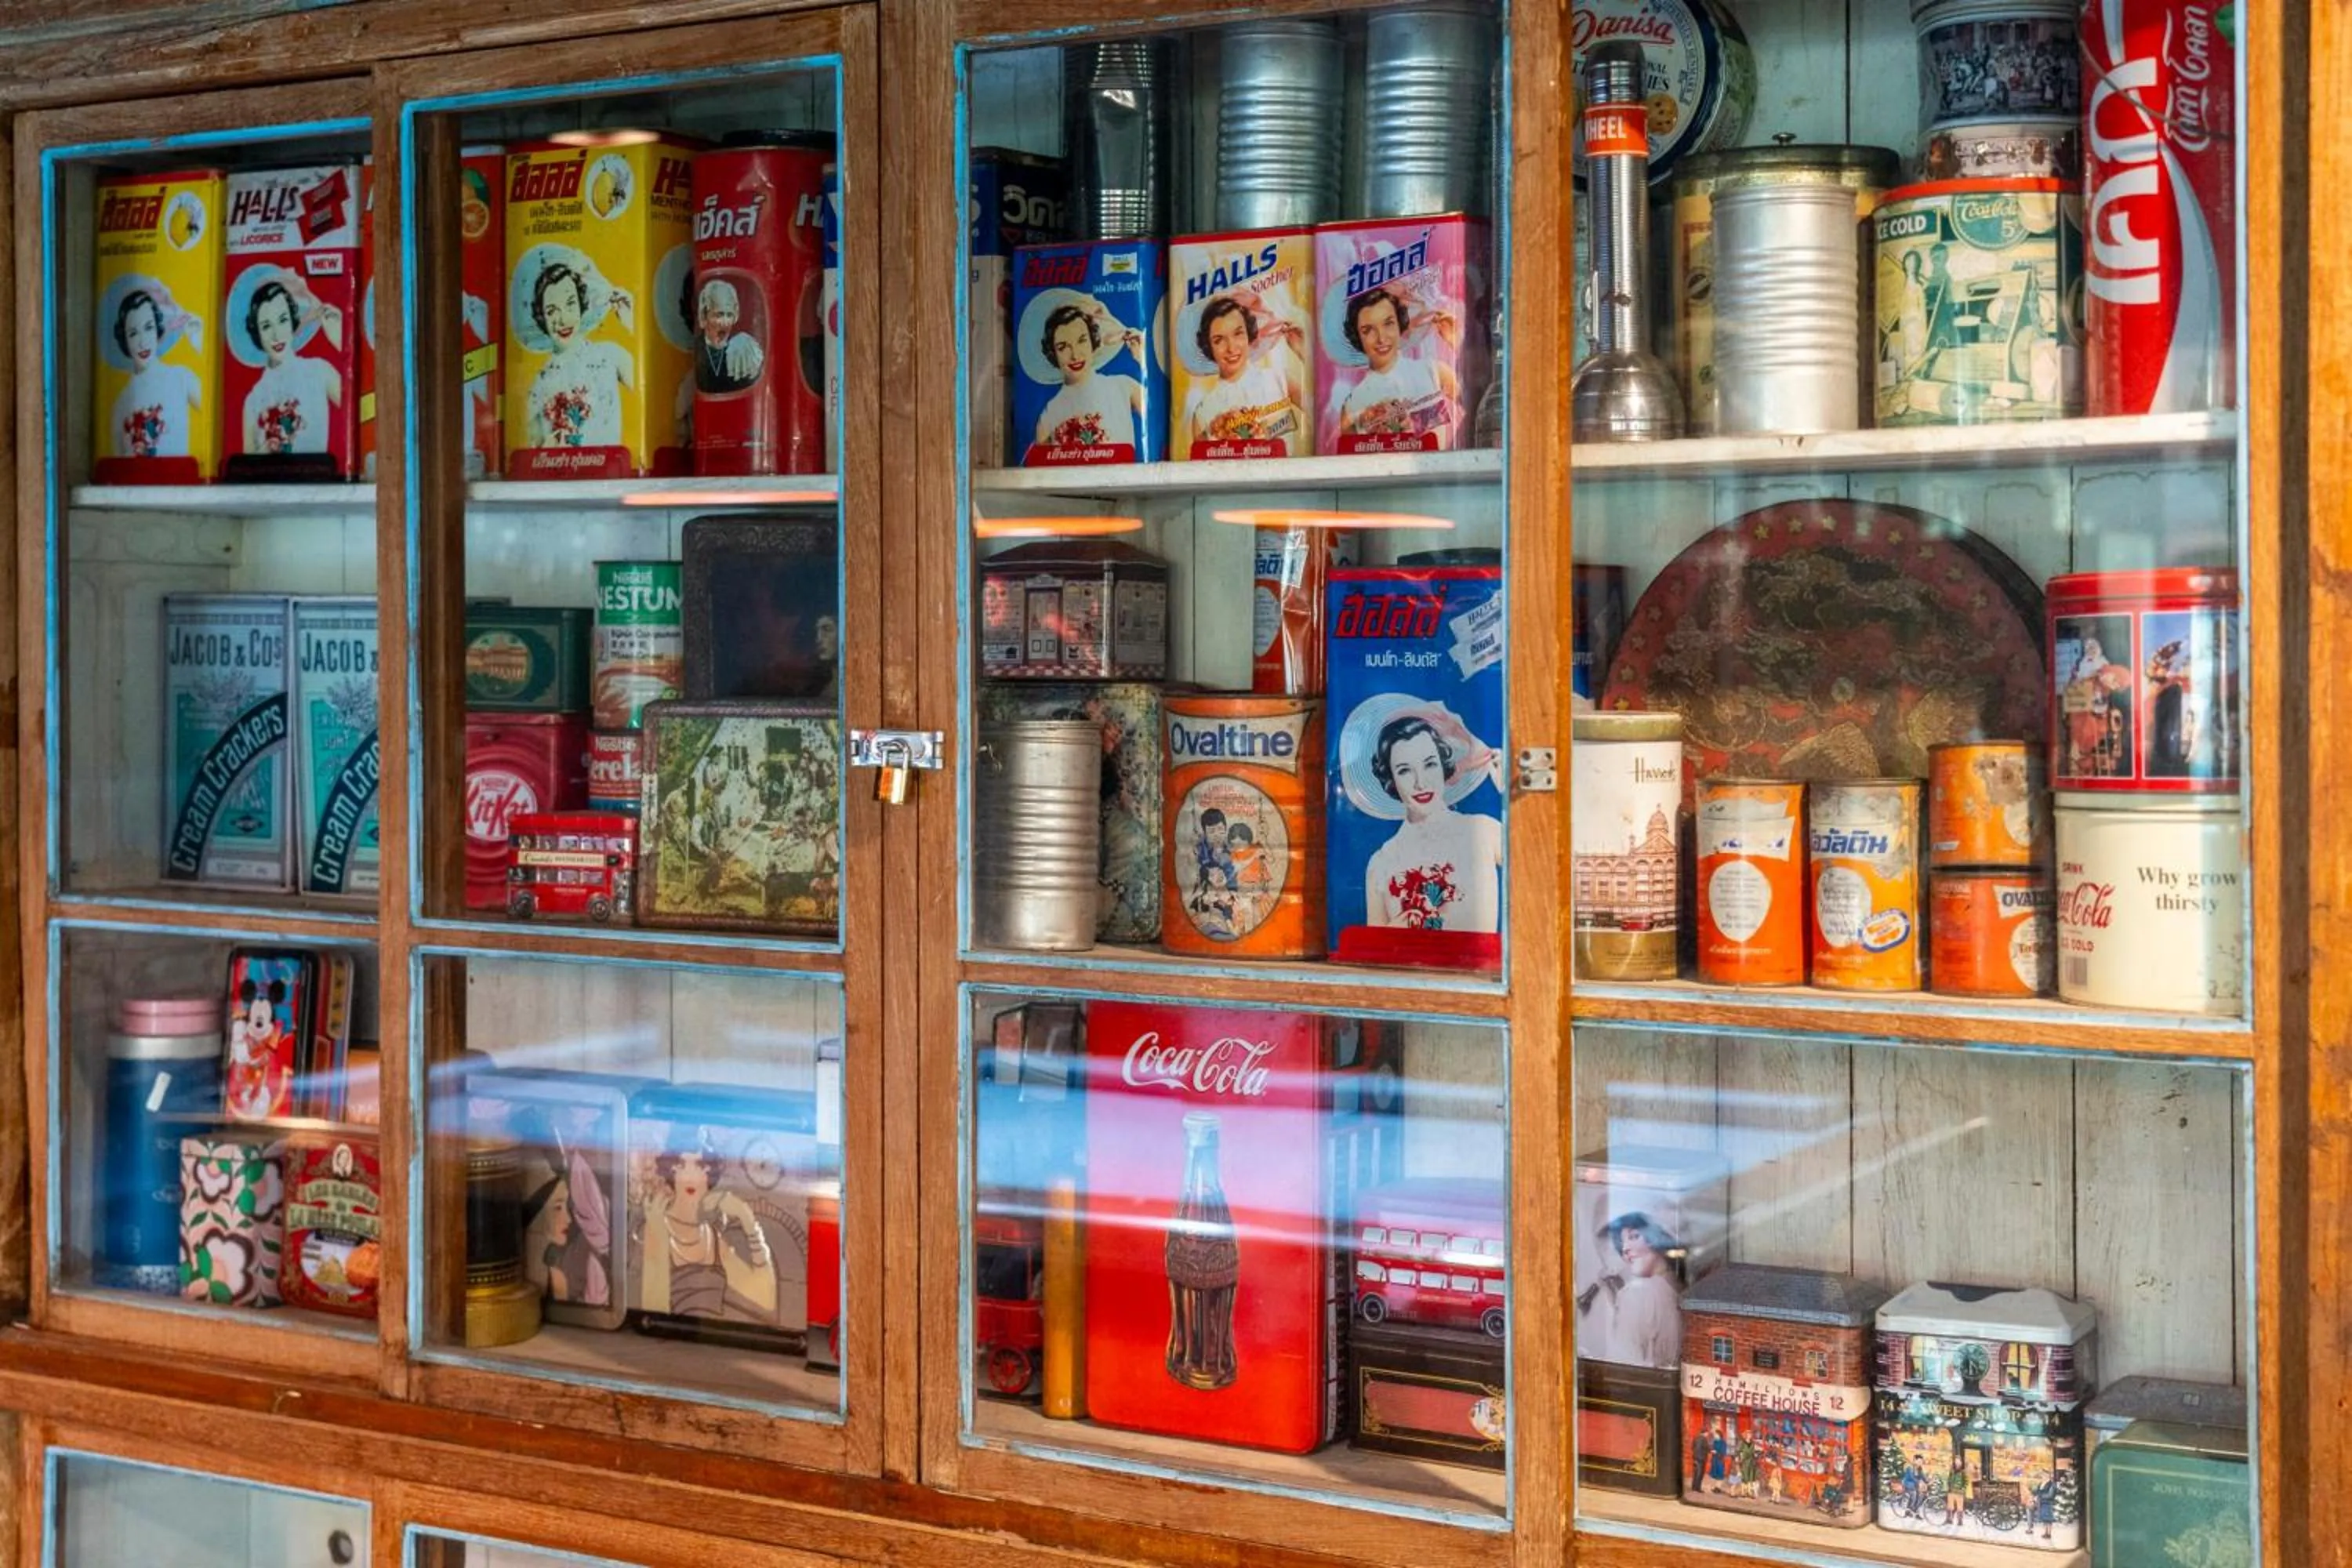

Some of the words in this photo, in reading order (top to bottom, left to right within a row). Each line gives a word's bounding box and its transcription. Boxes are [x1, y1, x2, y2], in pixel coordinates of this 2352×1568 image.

[1573, 7, 1675, 49] Danisa
[230, 187, 300, 226] HALLS
[241, 232, 285, 245] LICORICE
[1890, 215, 1927, 237] COLD
[311, 257, 339, 270] NEW
[1186, 243, 1278, 305] HALLS
[169, 626, 231, 666] JACOB
[235, 644, 246, 666] &
[301, 632, 365, 673] JACOB
[1171, 720, 1294, 757] Ovaltine
[170, 784, 218, 873] Cream
[202, 704, 285, 791] Crackers
[314, 793, 359, 886] Cream
[2136, 866, 2180, 890] Why
[2187, 872, 2238, 888] grow
[2155, 892, 2219, 915] thirsty
[1121, 1031, 1279, 1096] Coca-Cola
[1690, 1374, 1704, 1388] 12
[1715, 1377, 1820, 1401] HAMILTONS
[1713, 1387, 1769, 1409] COFFEE
[1773, 1396, 1822, 1417] HOUSE
[1829, 1396, 1844, 1410] 12
[1881, 1399, 1894, 1411] 14
[1921, 1404, 1973, 1419] SWEET
[1977, 1408, 2021, 1422] SHOP
[2045, 1414, 2060, 1426] 14
